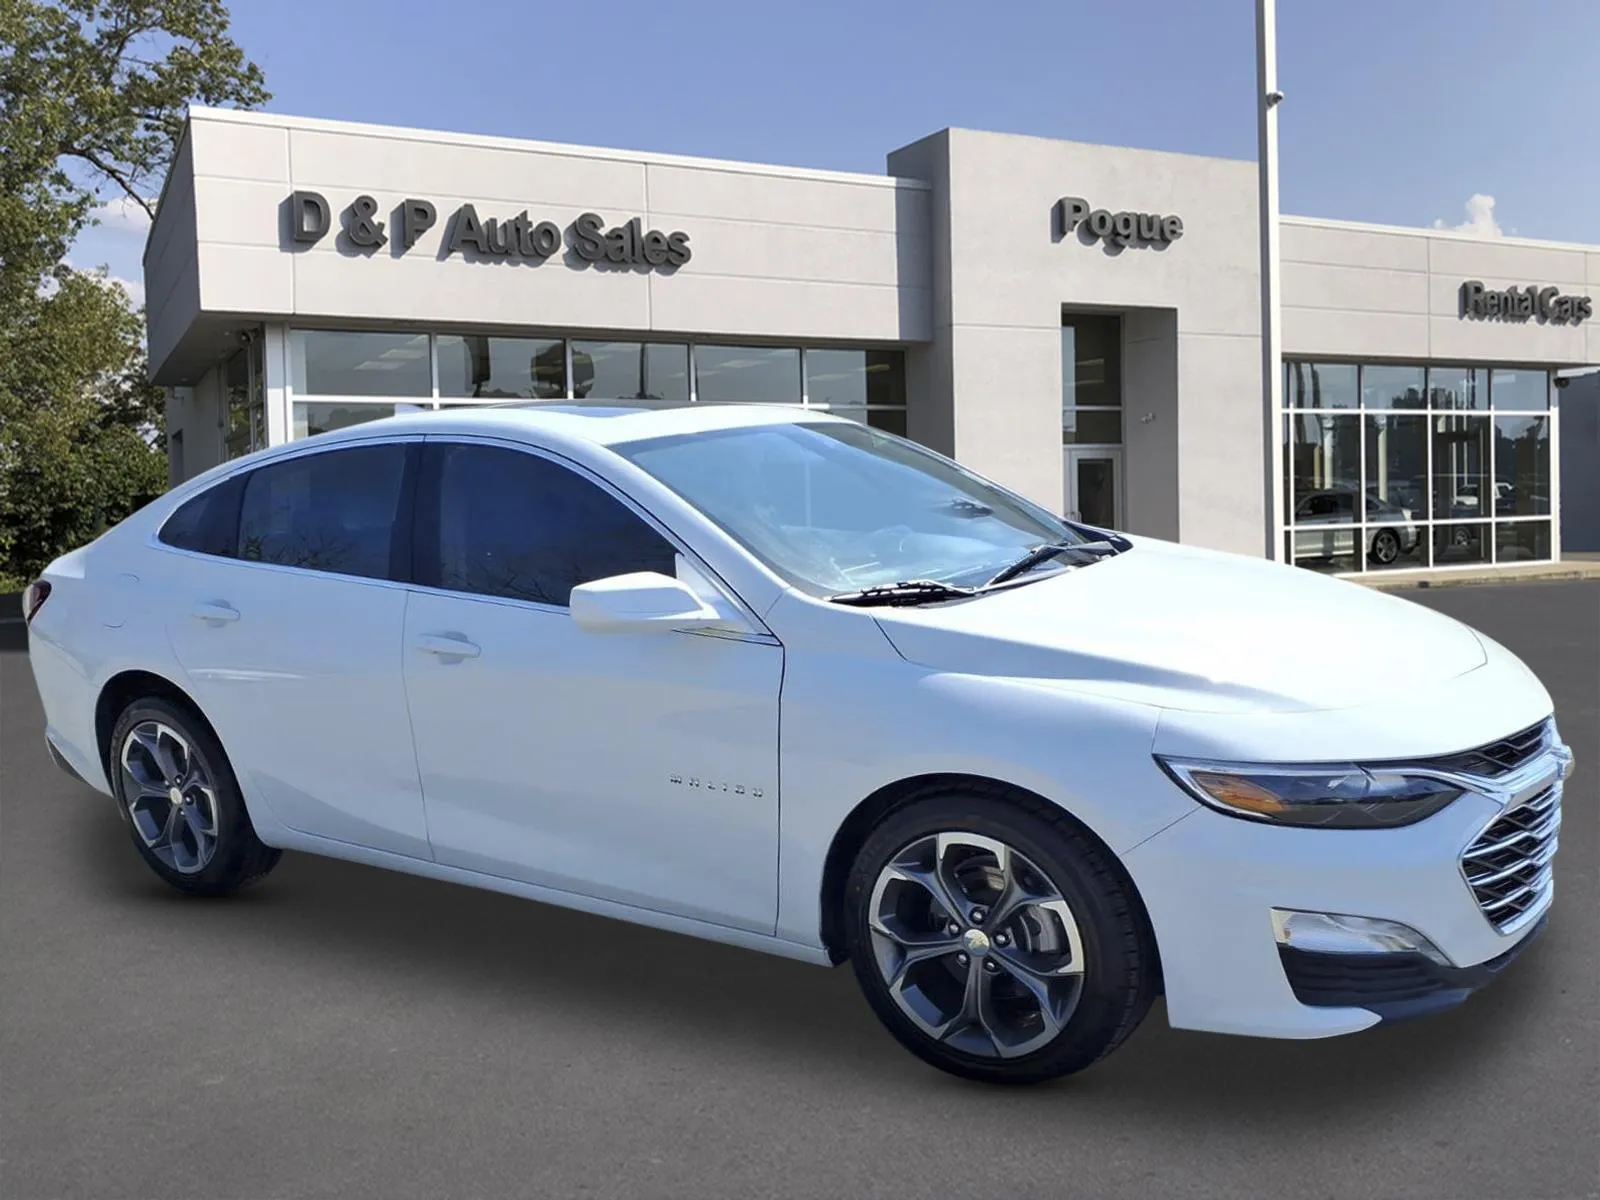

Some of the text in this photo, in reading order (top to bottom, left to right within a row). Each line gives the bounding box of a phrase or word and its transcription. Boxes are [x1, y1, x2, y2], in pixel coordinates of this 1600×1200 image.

[290, 190, 692, 272] D & P Auto Sales
[1055, 197, 1183, 252] Pogue
[1460, 280, 1592, 323] Rental Cars
